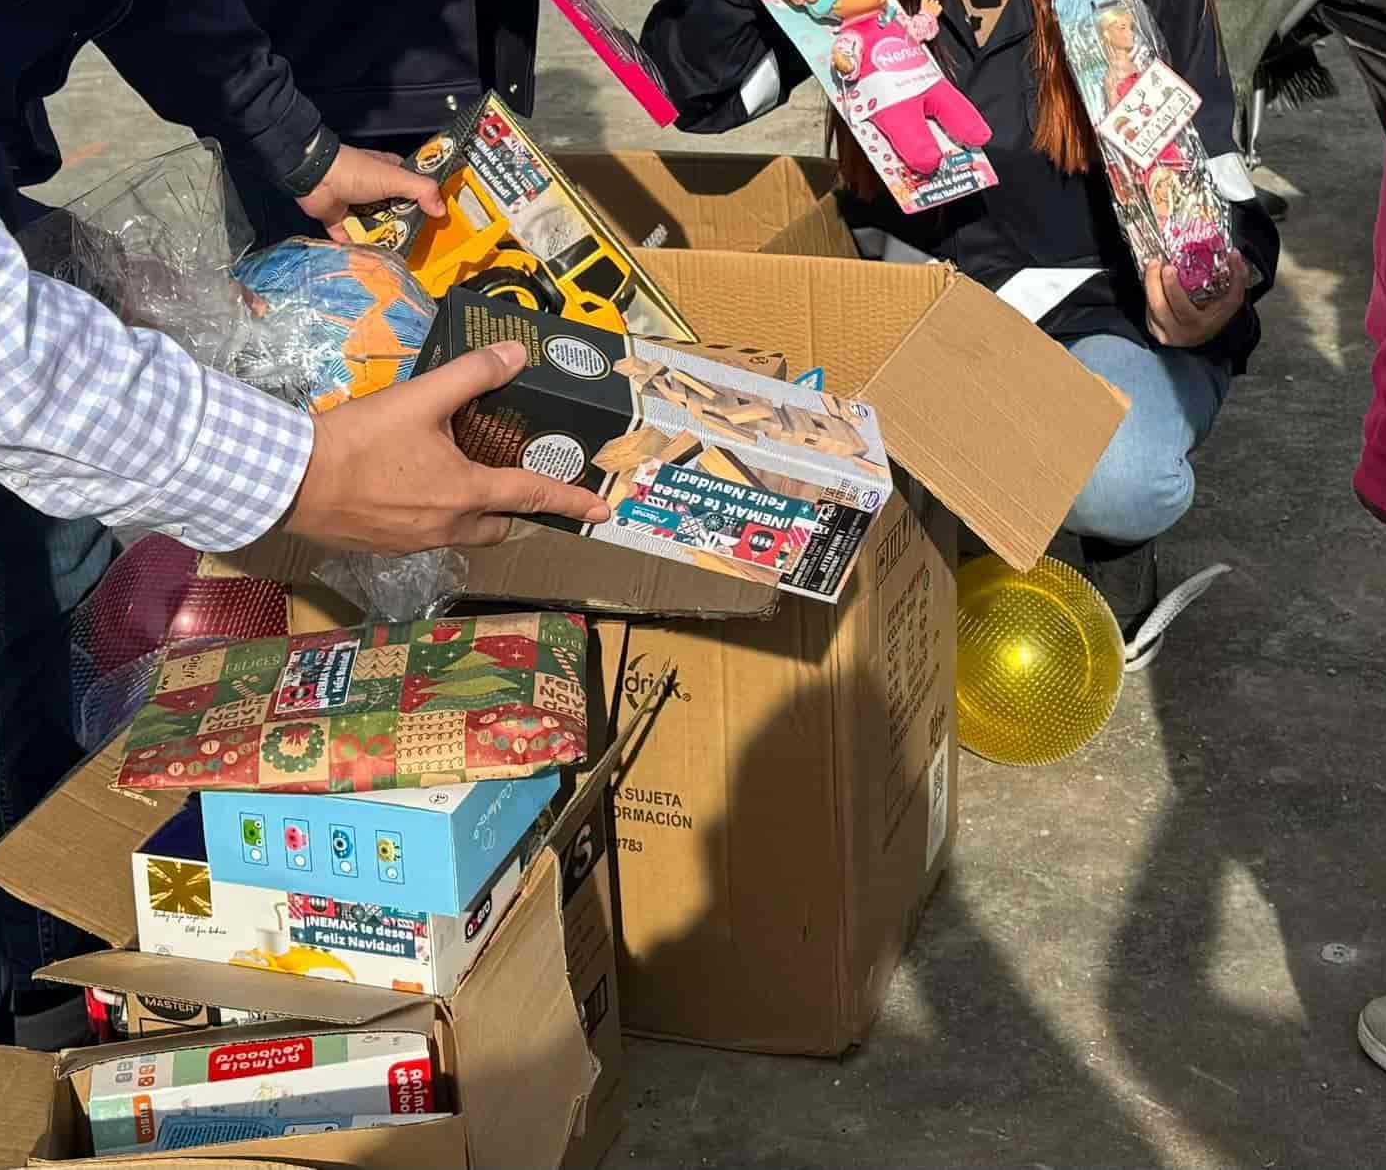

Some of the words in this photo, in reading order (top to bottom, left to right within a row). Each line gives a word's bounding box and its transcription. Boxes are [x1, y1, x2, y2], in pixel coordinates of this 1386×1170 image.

[651, 482, 702, 506] desea
[670, 469, 740, 501] Navidad!
[703, 494, 720, 509] te
[742, 491, 789, 511] Feliz
[206, 706, 263, 724] Navi
[207, 715, 256, 732] dad
[624, 787, 683, 809] SUJETA
[305, 915, 358, 933] ¡NEMAK
[360, 922, 374, 934] te
[375, 924, 414, 941] desea
[314, 931, 346, 946] Feliz
[348, 936, 406, 955] Navidad!
[144, 996, 194, 1014] MASTER
[215, 1042, 306, 1065] keyboard
[219, 1053, 301, 1072] animals
